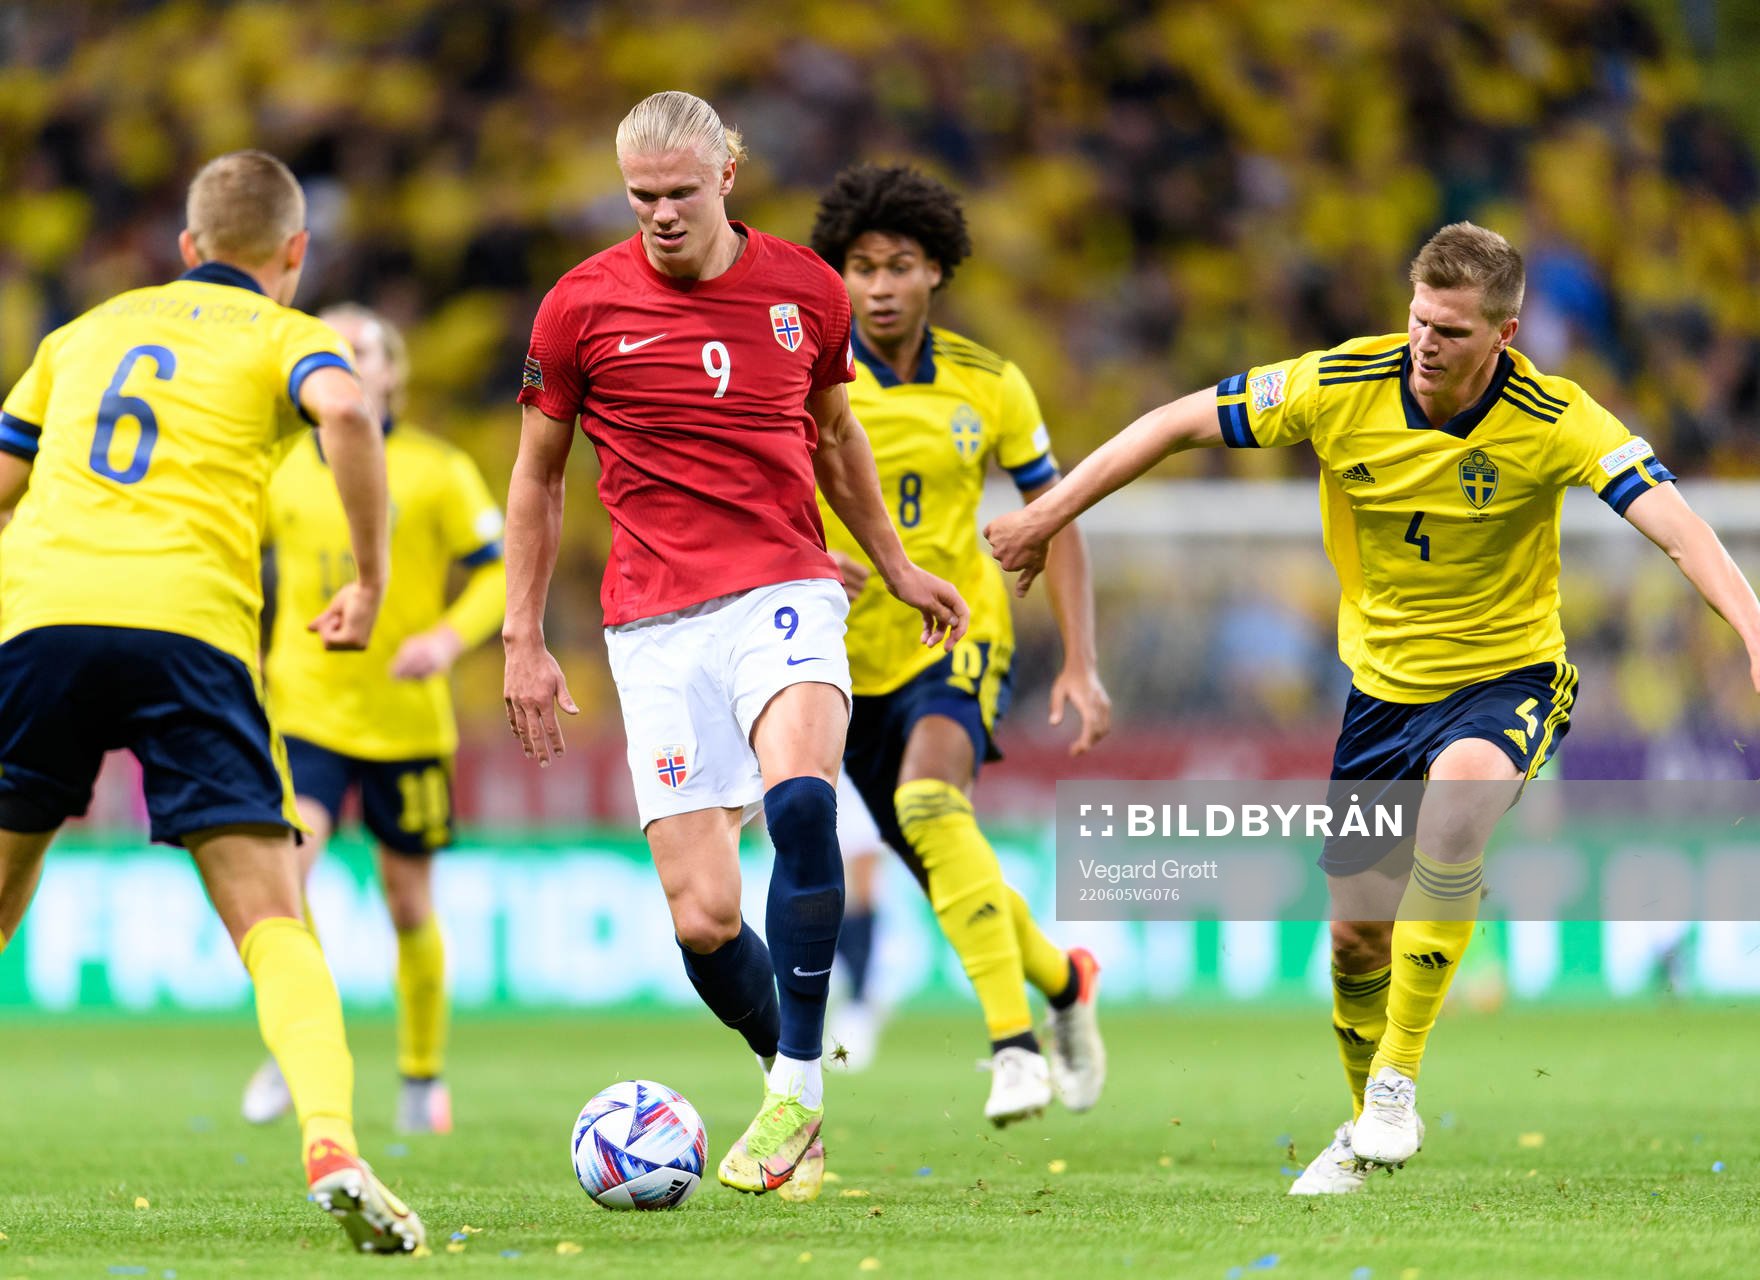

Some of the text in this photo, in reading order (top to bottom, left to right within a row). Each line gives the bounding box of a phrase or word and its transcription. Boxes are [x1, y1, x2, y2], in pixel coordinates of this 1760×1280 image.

[702, 341, 731, 398] 9
[89, 345, 177, 485] 6
[899, 473, 922, 529] 8
[1342, 471, 1376, 484] adidas
[1404, 511, 1430, 561] 4
[774, 606, 799, 640] 9
[1515, 697, 1538, 739] 4
